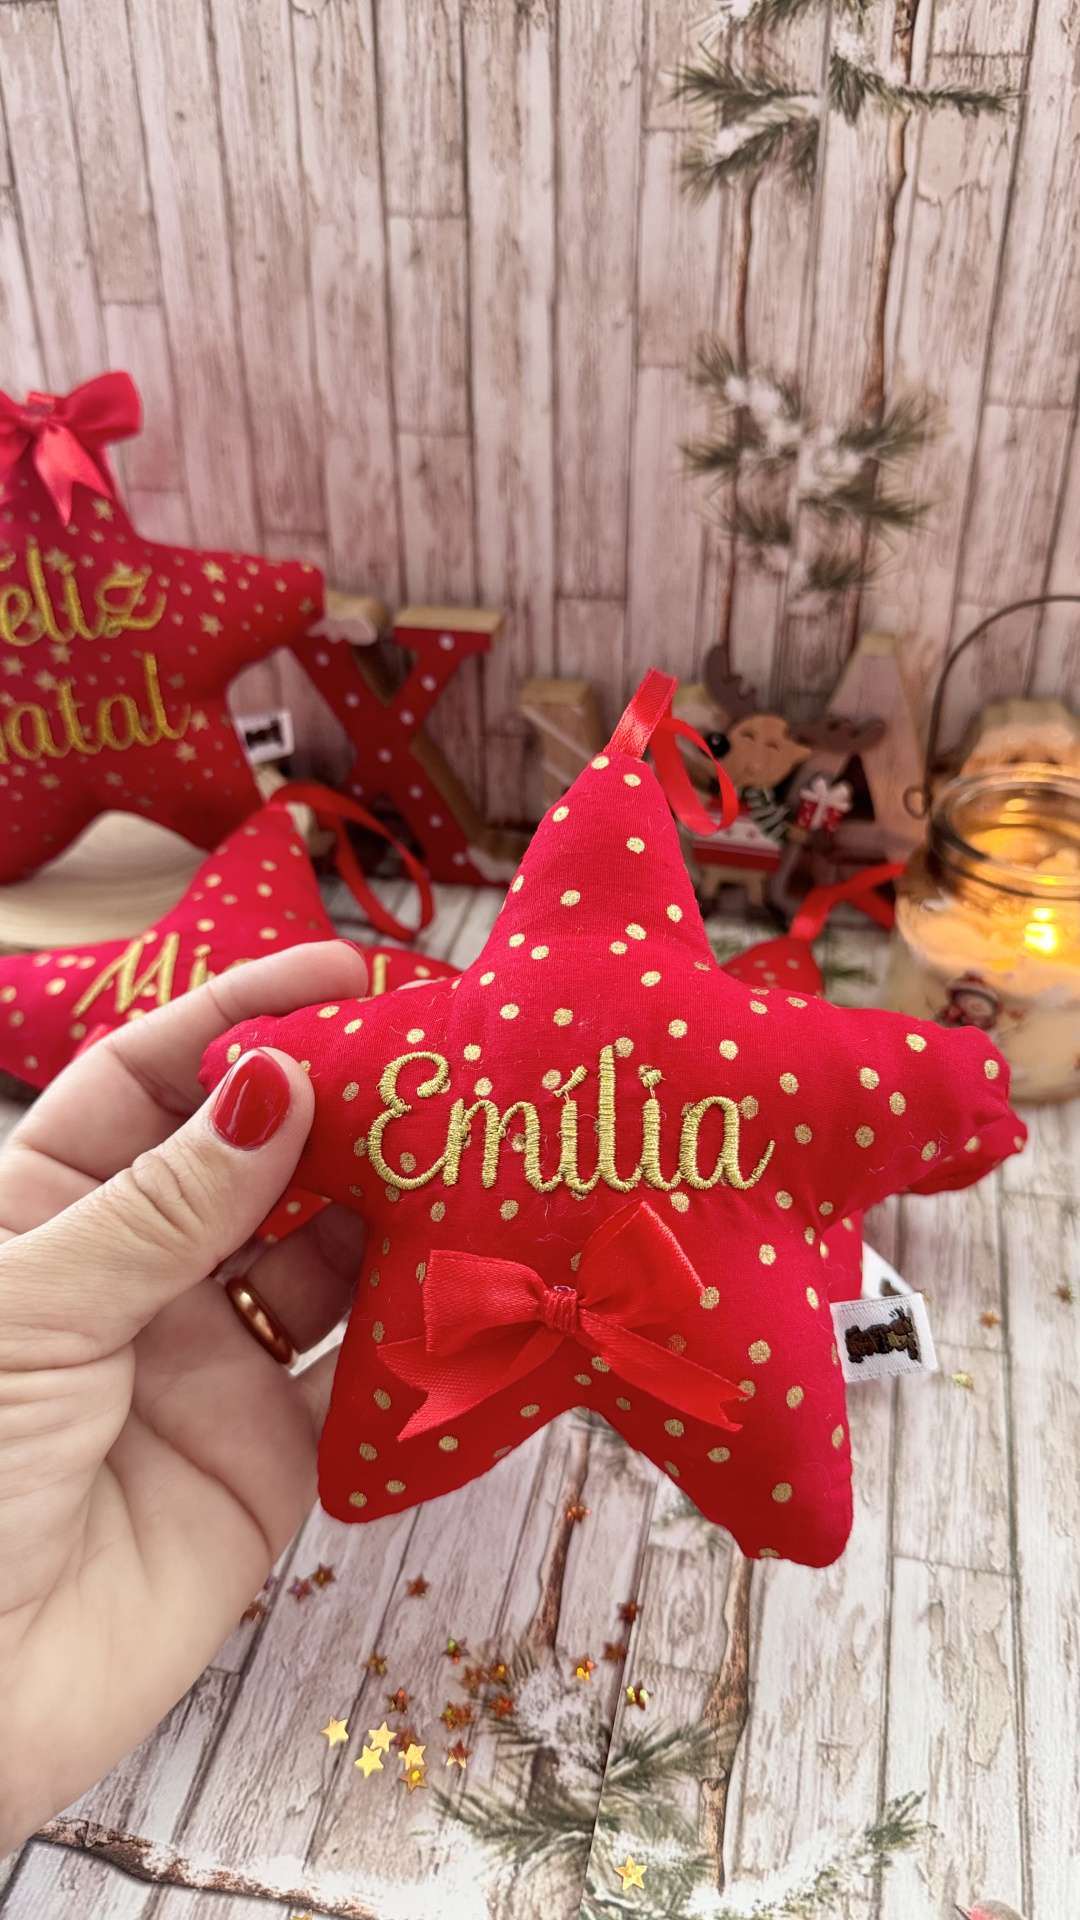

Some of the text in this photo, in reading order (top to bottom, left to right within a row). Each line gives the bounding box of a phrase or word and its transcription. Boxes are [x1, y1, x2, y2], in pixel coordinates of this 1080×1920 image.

[0, 540, 167, 647] eliz
[0, 652, 191, 765] atal
[368, 1045, 776, 1193] Emília
